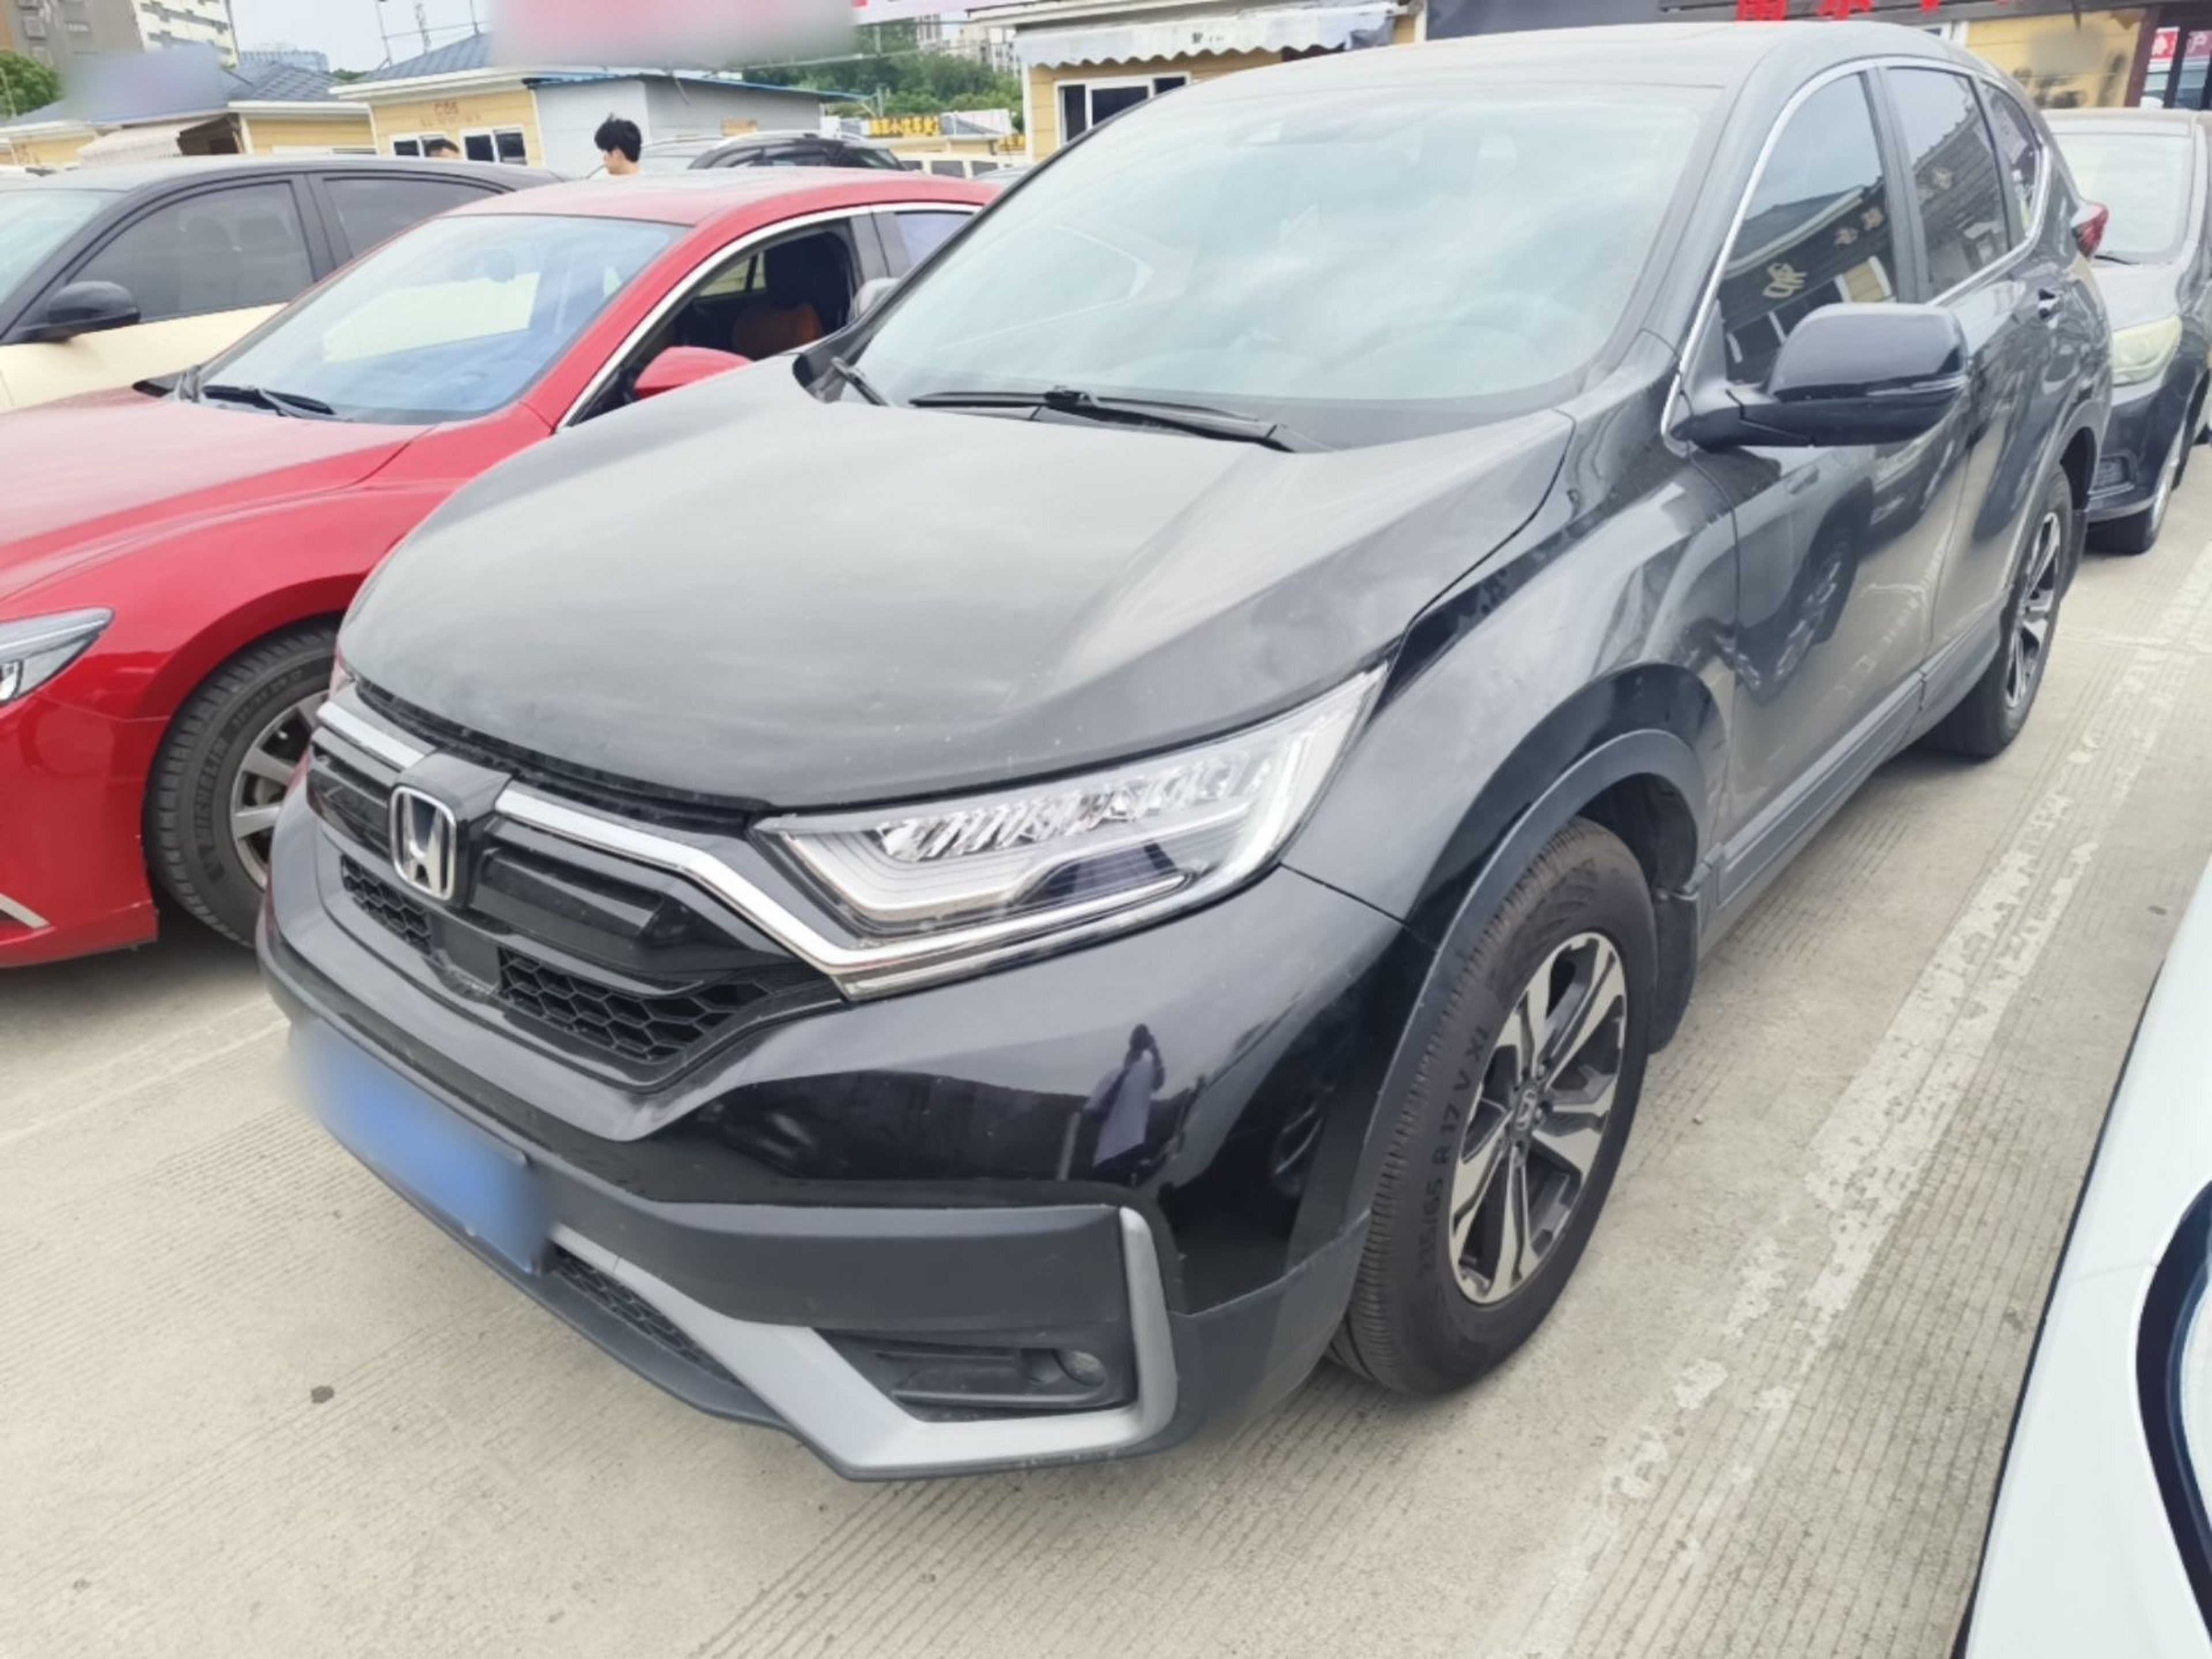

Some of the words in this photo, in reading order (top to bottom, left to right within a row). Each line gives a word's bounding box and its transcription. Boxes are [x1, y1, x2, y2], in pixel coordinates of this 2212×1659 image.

[194, 737, 229, 841] MICHELIN
[1464, 1025, 1491, 1062] XL
[1453, 1069, 1471, 1091] V
[1440, 1103, 1461, 1134] 17
[1432, 1144, 1450, 1166] R
